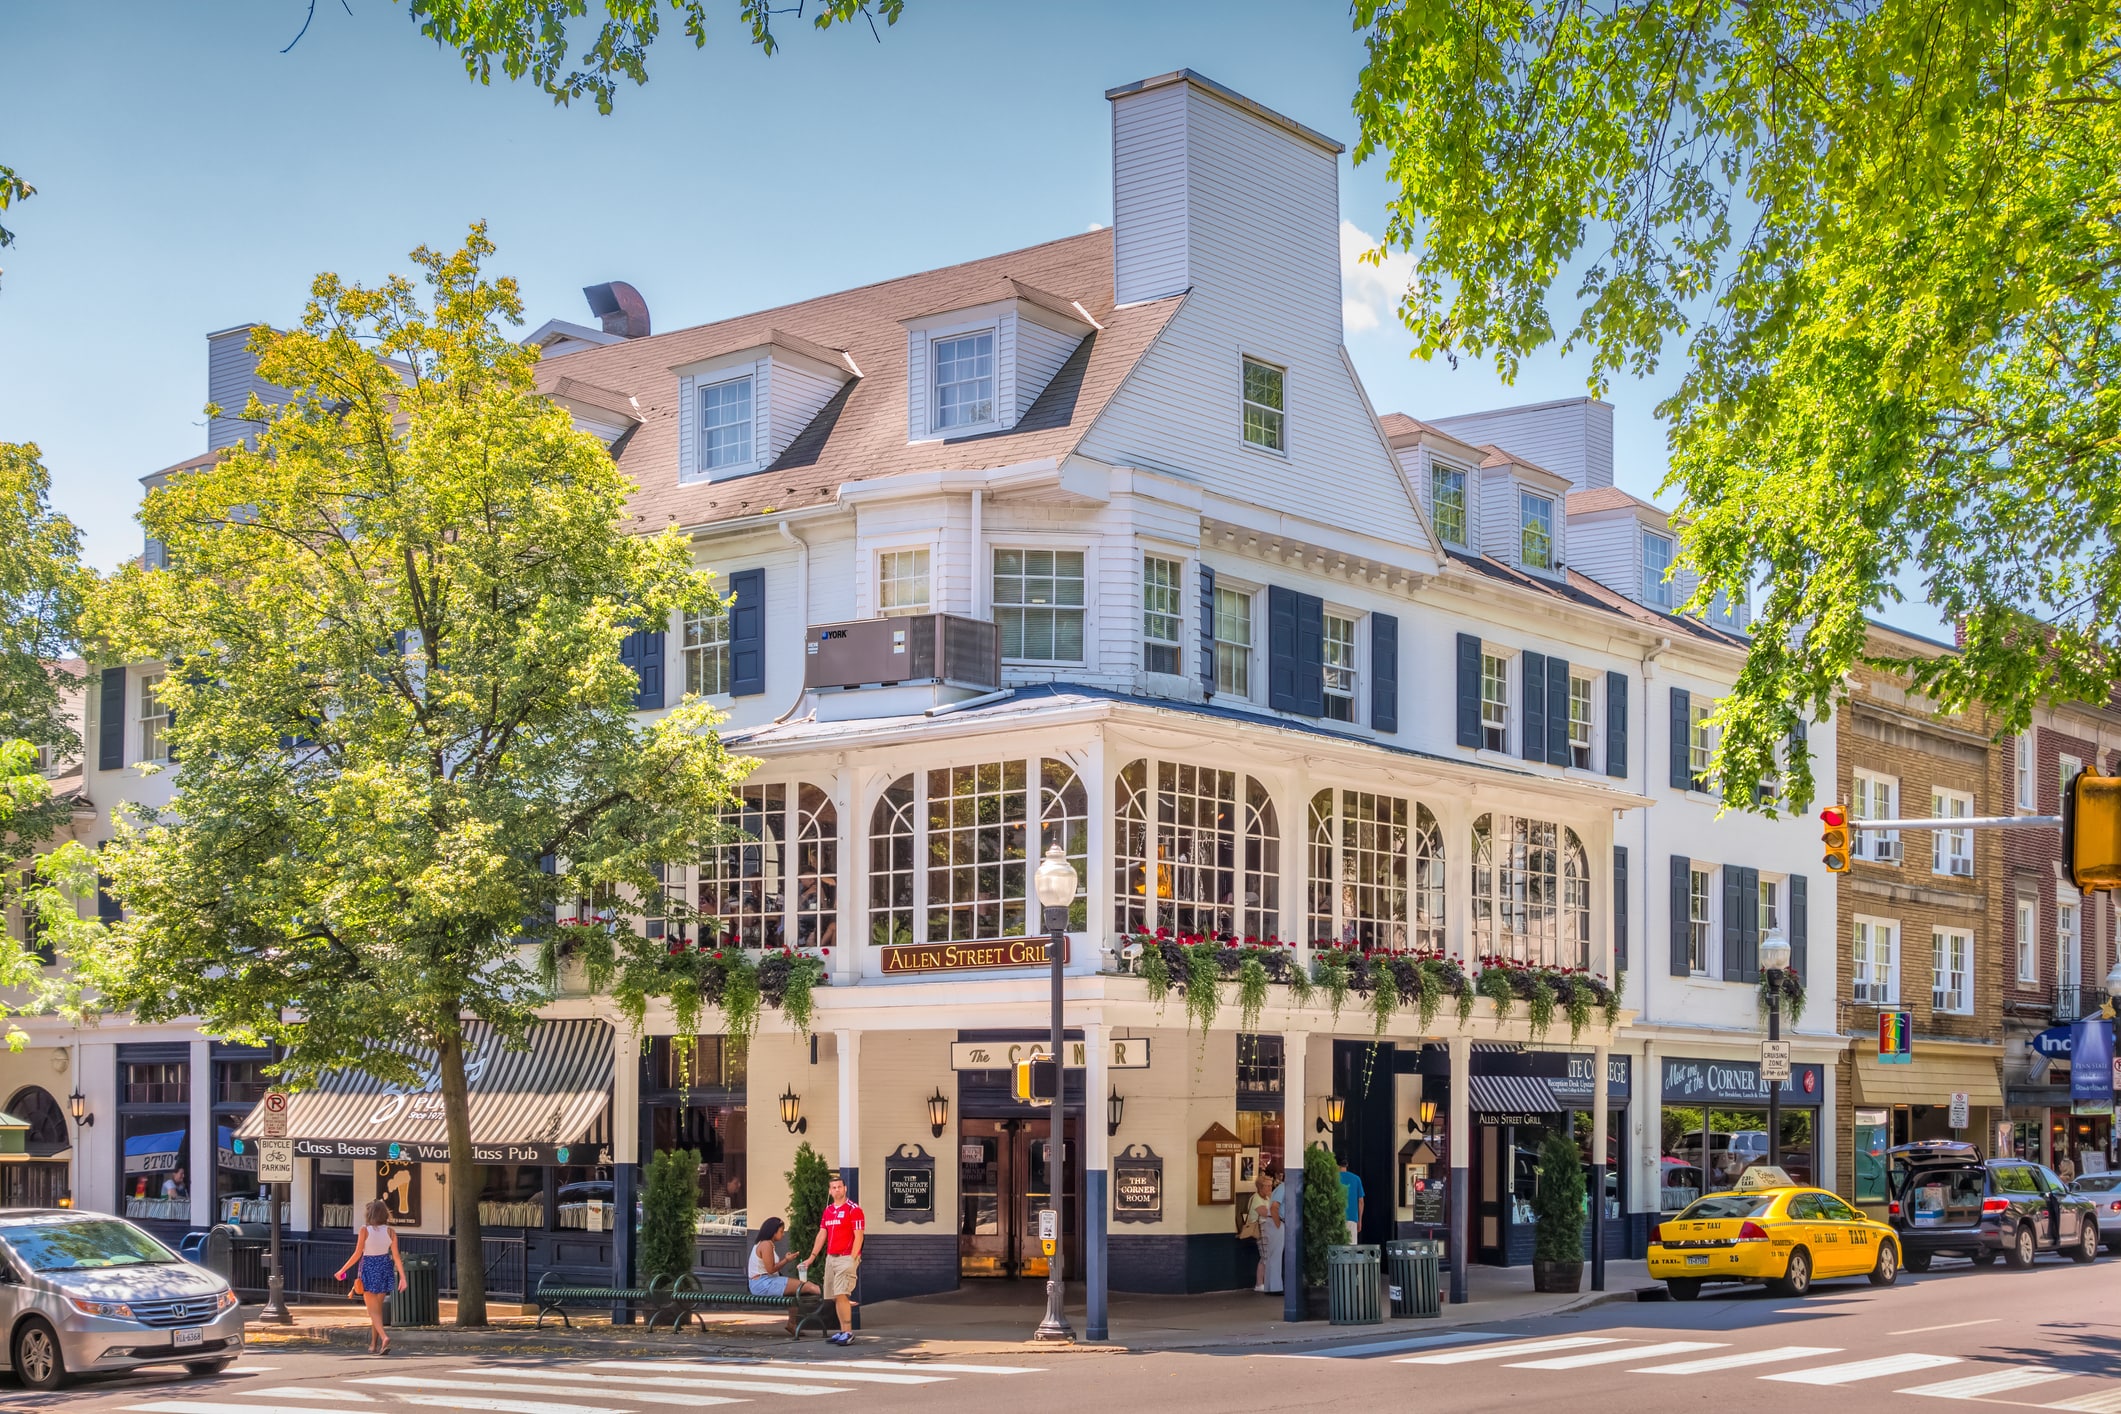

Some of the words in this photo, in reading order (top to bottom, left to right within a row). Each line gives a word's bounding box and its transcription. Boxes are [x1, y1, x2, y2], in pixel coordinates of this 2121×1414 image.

[828, 630, 848, 639] YORK
[889, 949, 941, 970] ALLEN
[945, 946, 1004, 967] STREET
[1009, 941, 1051, 963] GRIL
[969, 1049, 990, 1063] The
[1008, 1043, 1127, 1065] CNR
[1584, 1058, 1627, 1083] CEGE
[1665, 1063, 1685, 1090] Meet
[1688, 1064, 1698, 1077] me
[1548, 1079, 1569, 1088] Reception
[1569, 1079, 1580, 1087] Desk
[1580, 1080, 1595, 1088] Upstair
[1685, 1081, 1692, 1094] at
[1694, 1071, 1704, 1090] the
[1707, 1065, 1755, 1092] CORNER
[1760, 1067, 1793, 1093] RM
[413, 1097, 446, 1109] PU
[408, 1111, 427, 1119] Since
[427, 1111, 446, 1120] 1972
[1479, 1113, 1499, 1124] ALLEN
[1501, 1113, 1522, 1124] STREET
[1523, 1113, 1542, 1125] GRILL
[338, 1143, 377, 1156] Beers
[509, 1147, 538, 1160] Pub
[262, 1164, 290, 1172] PARKING
[1129, 1177, 1147, 1185] THE
[1121, 1185, 1156, 1194] CORNER
[1126, 1194, 1151, 1202] ROOM
[1707, 1222, 1721, 1230] TAXI
[1824, 1233, 1838, 1243] TAXI
[1848, 1229, 1868, 1245] TAXI
[1729, 1255, 1739, 1263] 25
